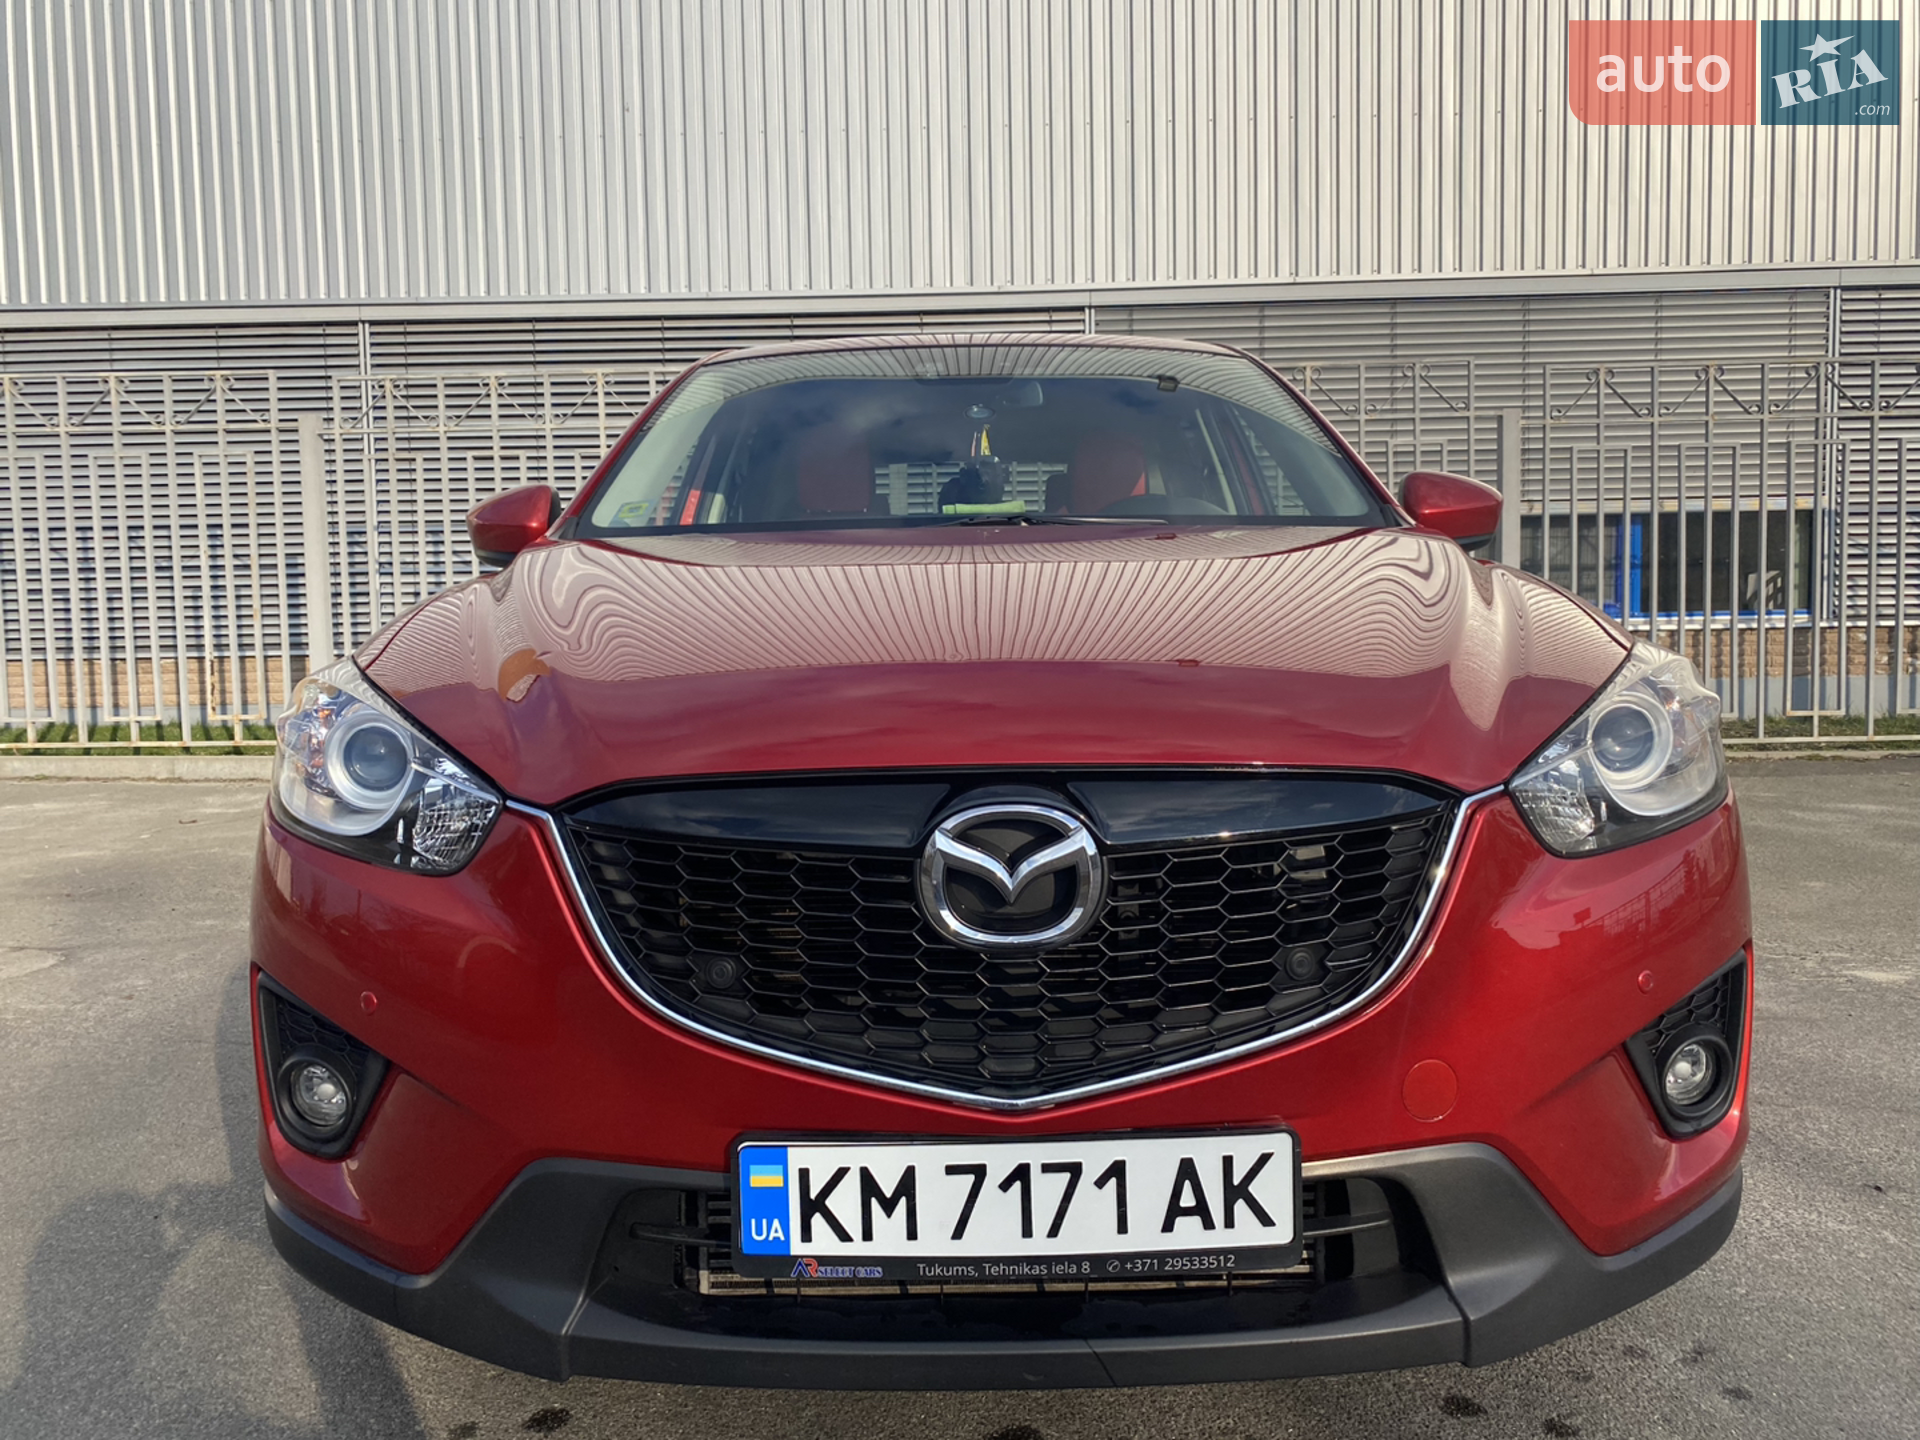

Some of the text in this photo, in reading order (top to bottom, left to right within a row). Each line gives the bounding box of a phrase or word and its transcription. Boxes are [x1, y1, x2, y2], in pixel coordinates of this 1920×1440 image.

[798, 1151, 1277, 1243] KM 7171 AK
[750, 1218, 785, 1241] UA
[855, 1266, 884, 1278] CARS
[917, 1254, 1236, 1278] Tukums, Tehnikas iela 8 +371 29533512
